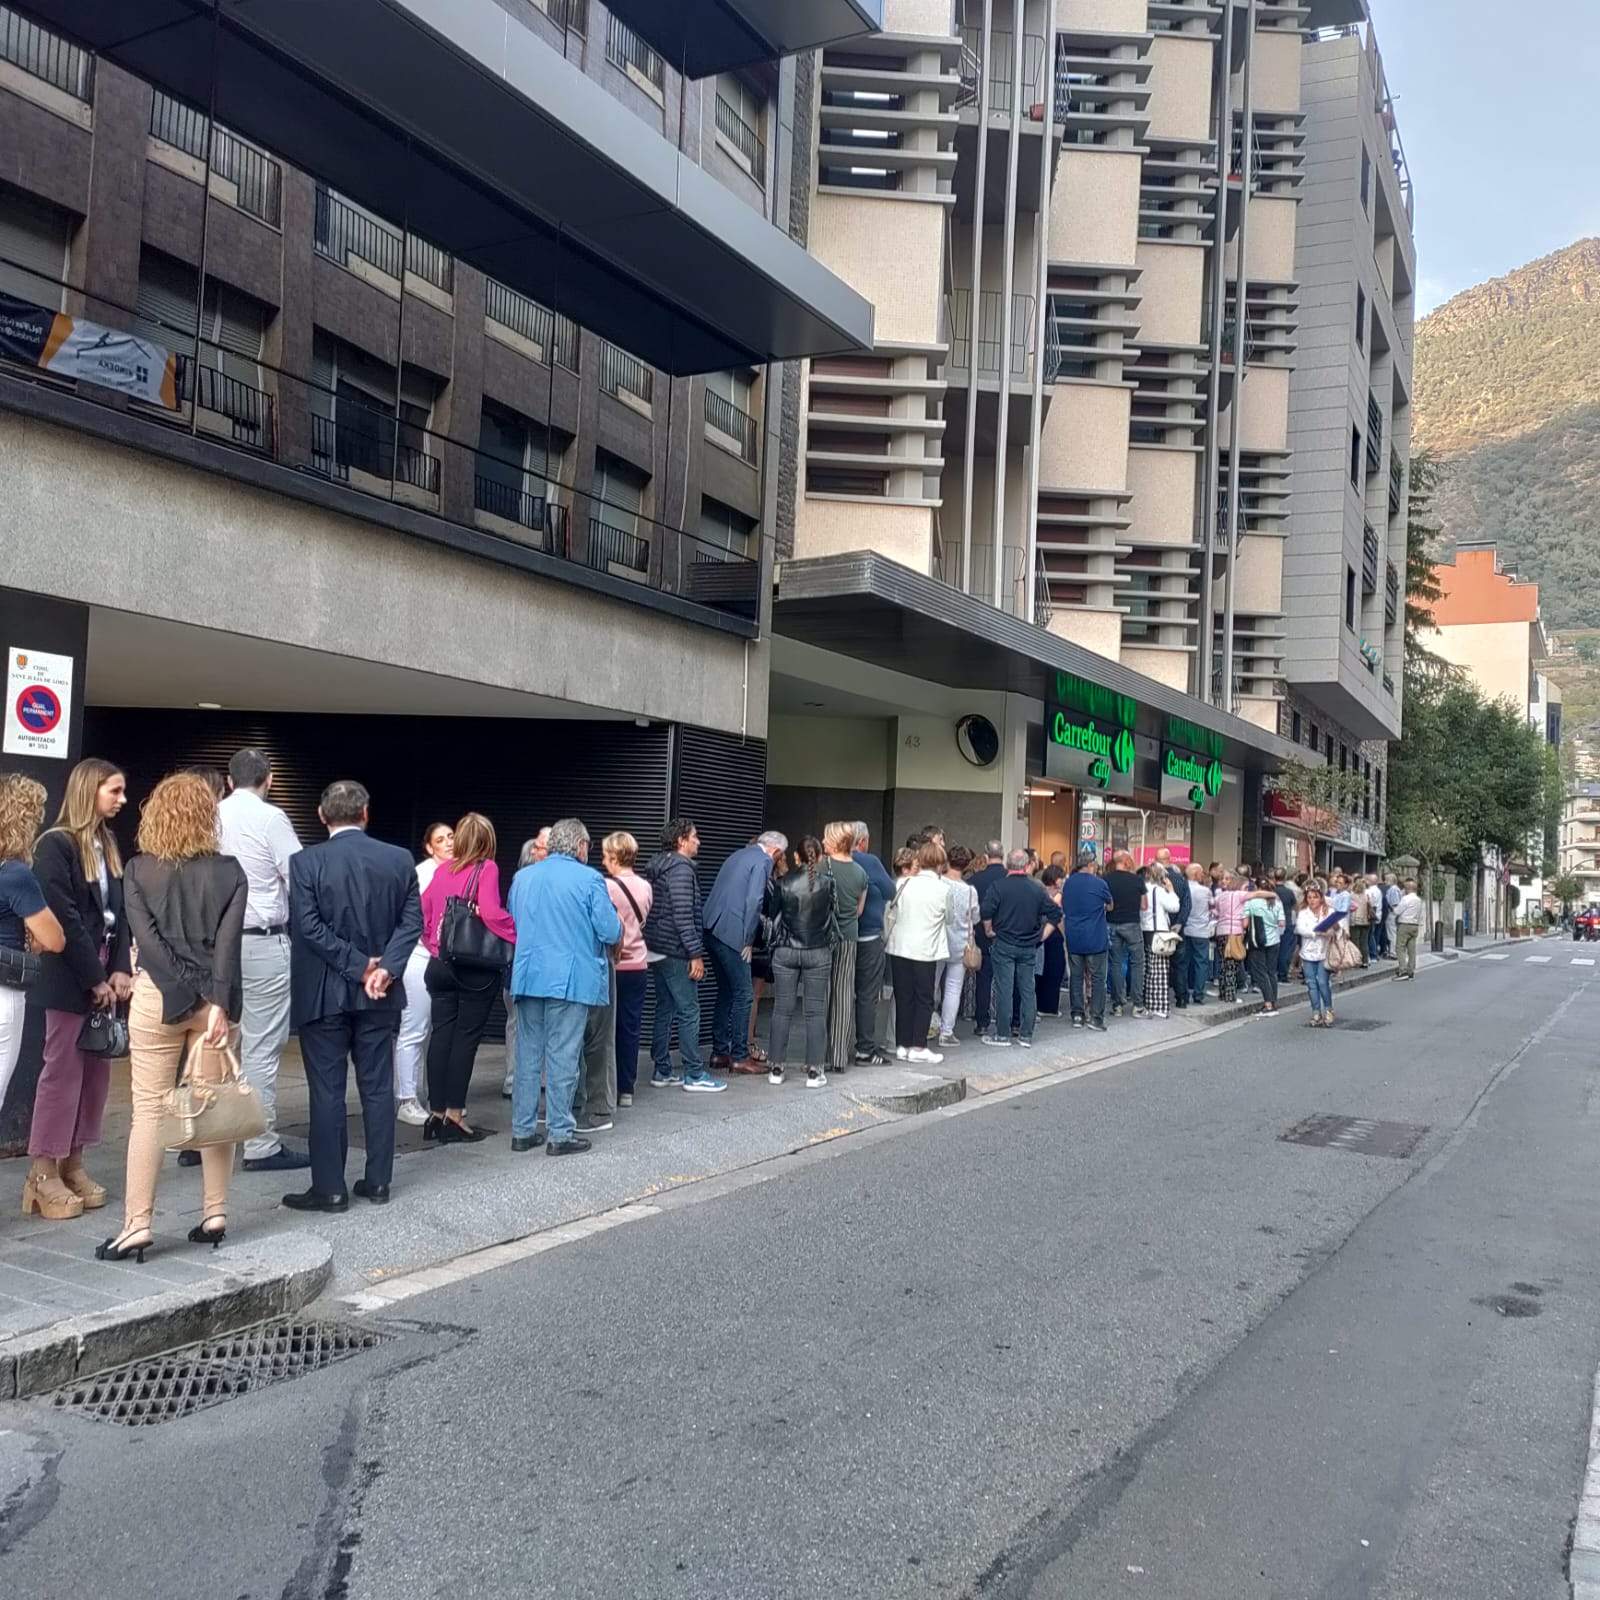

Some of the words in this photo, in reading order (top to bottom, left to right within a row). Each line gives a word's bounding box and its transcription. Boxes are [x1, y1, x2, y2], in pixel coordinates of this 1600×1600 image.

[23, 706, 54, 717] PERMANENT
[904, 735, 921, 748] 43
[1054, 711, 1112, 757] Carrefour
[1093, 758, 1110, 788] city
[1167, 750, 1206, 785] Carrefour
[1191, 786, 1205, 809] city
